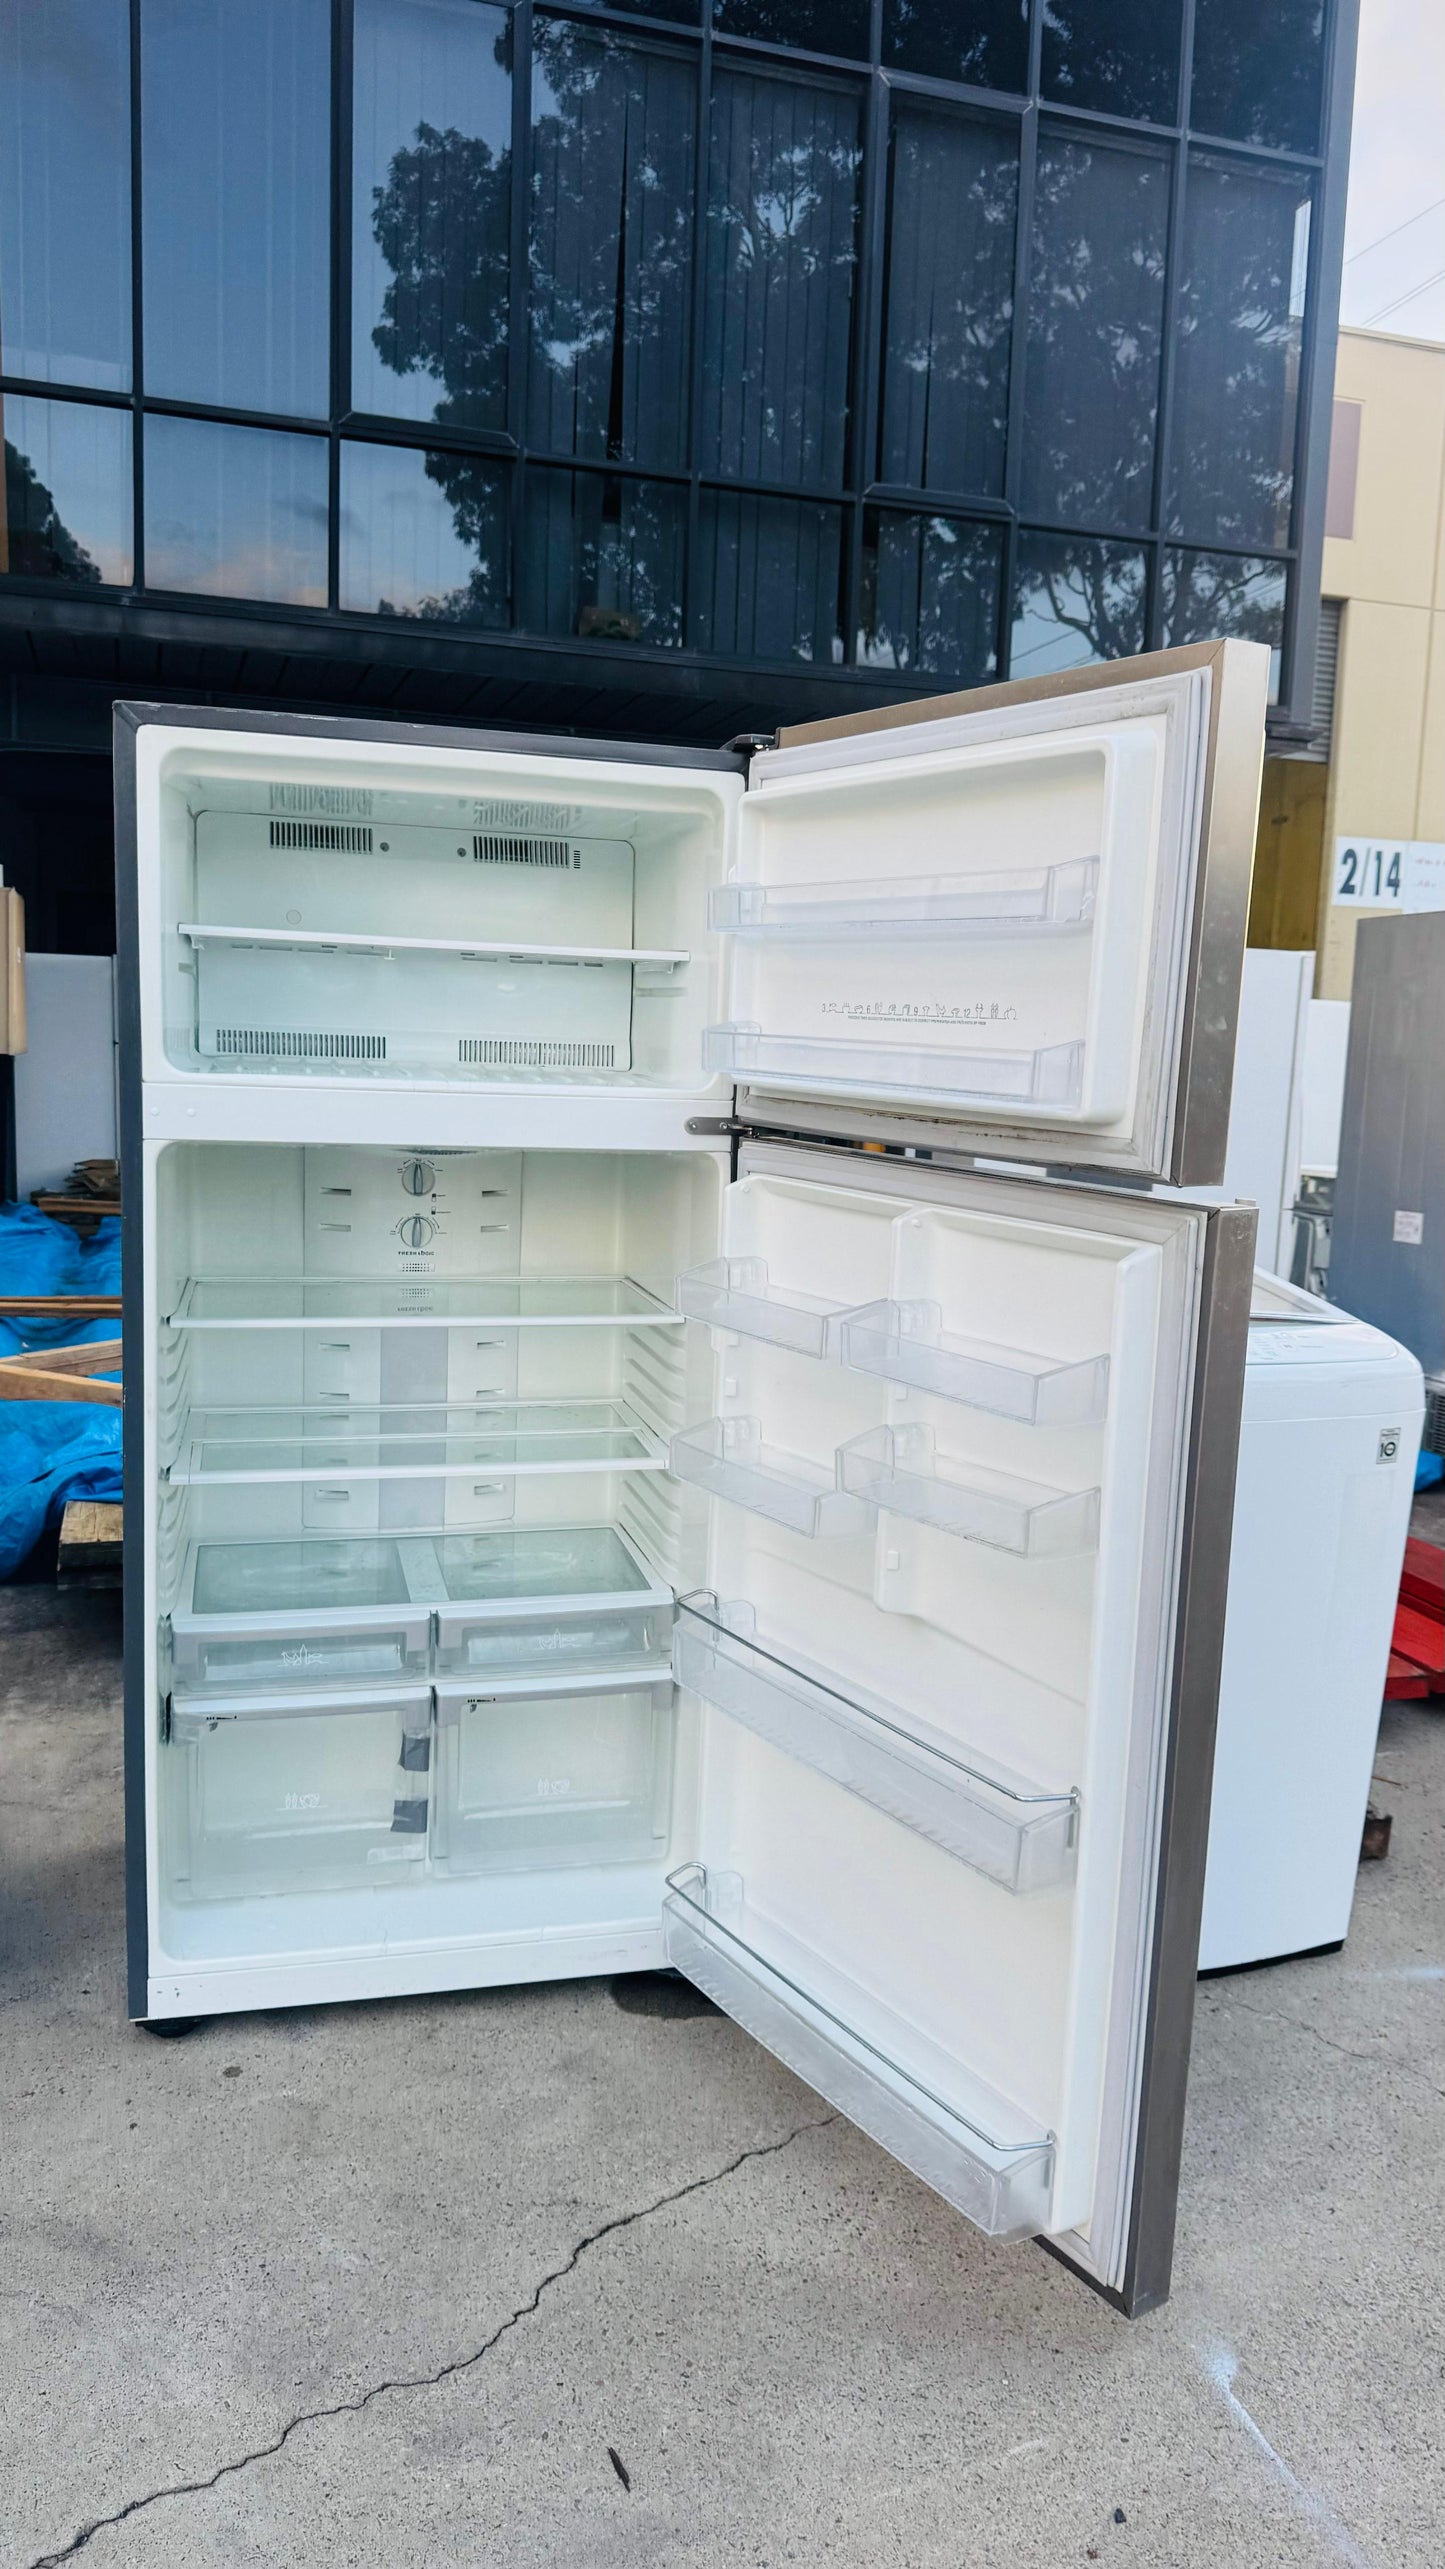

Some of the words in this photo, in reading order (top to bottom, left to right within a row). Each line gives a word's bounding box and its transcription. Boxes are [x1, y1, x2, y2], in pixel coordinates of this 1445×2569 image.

[1339, 848, 1401, 897] 2/14
[866, 1005, 871, 1015] 6
[913, 1006, 919, 1016] 9
[963, 1008, 971, 1018] 12
